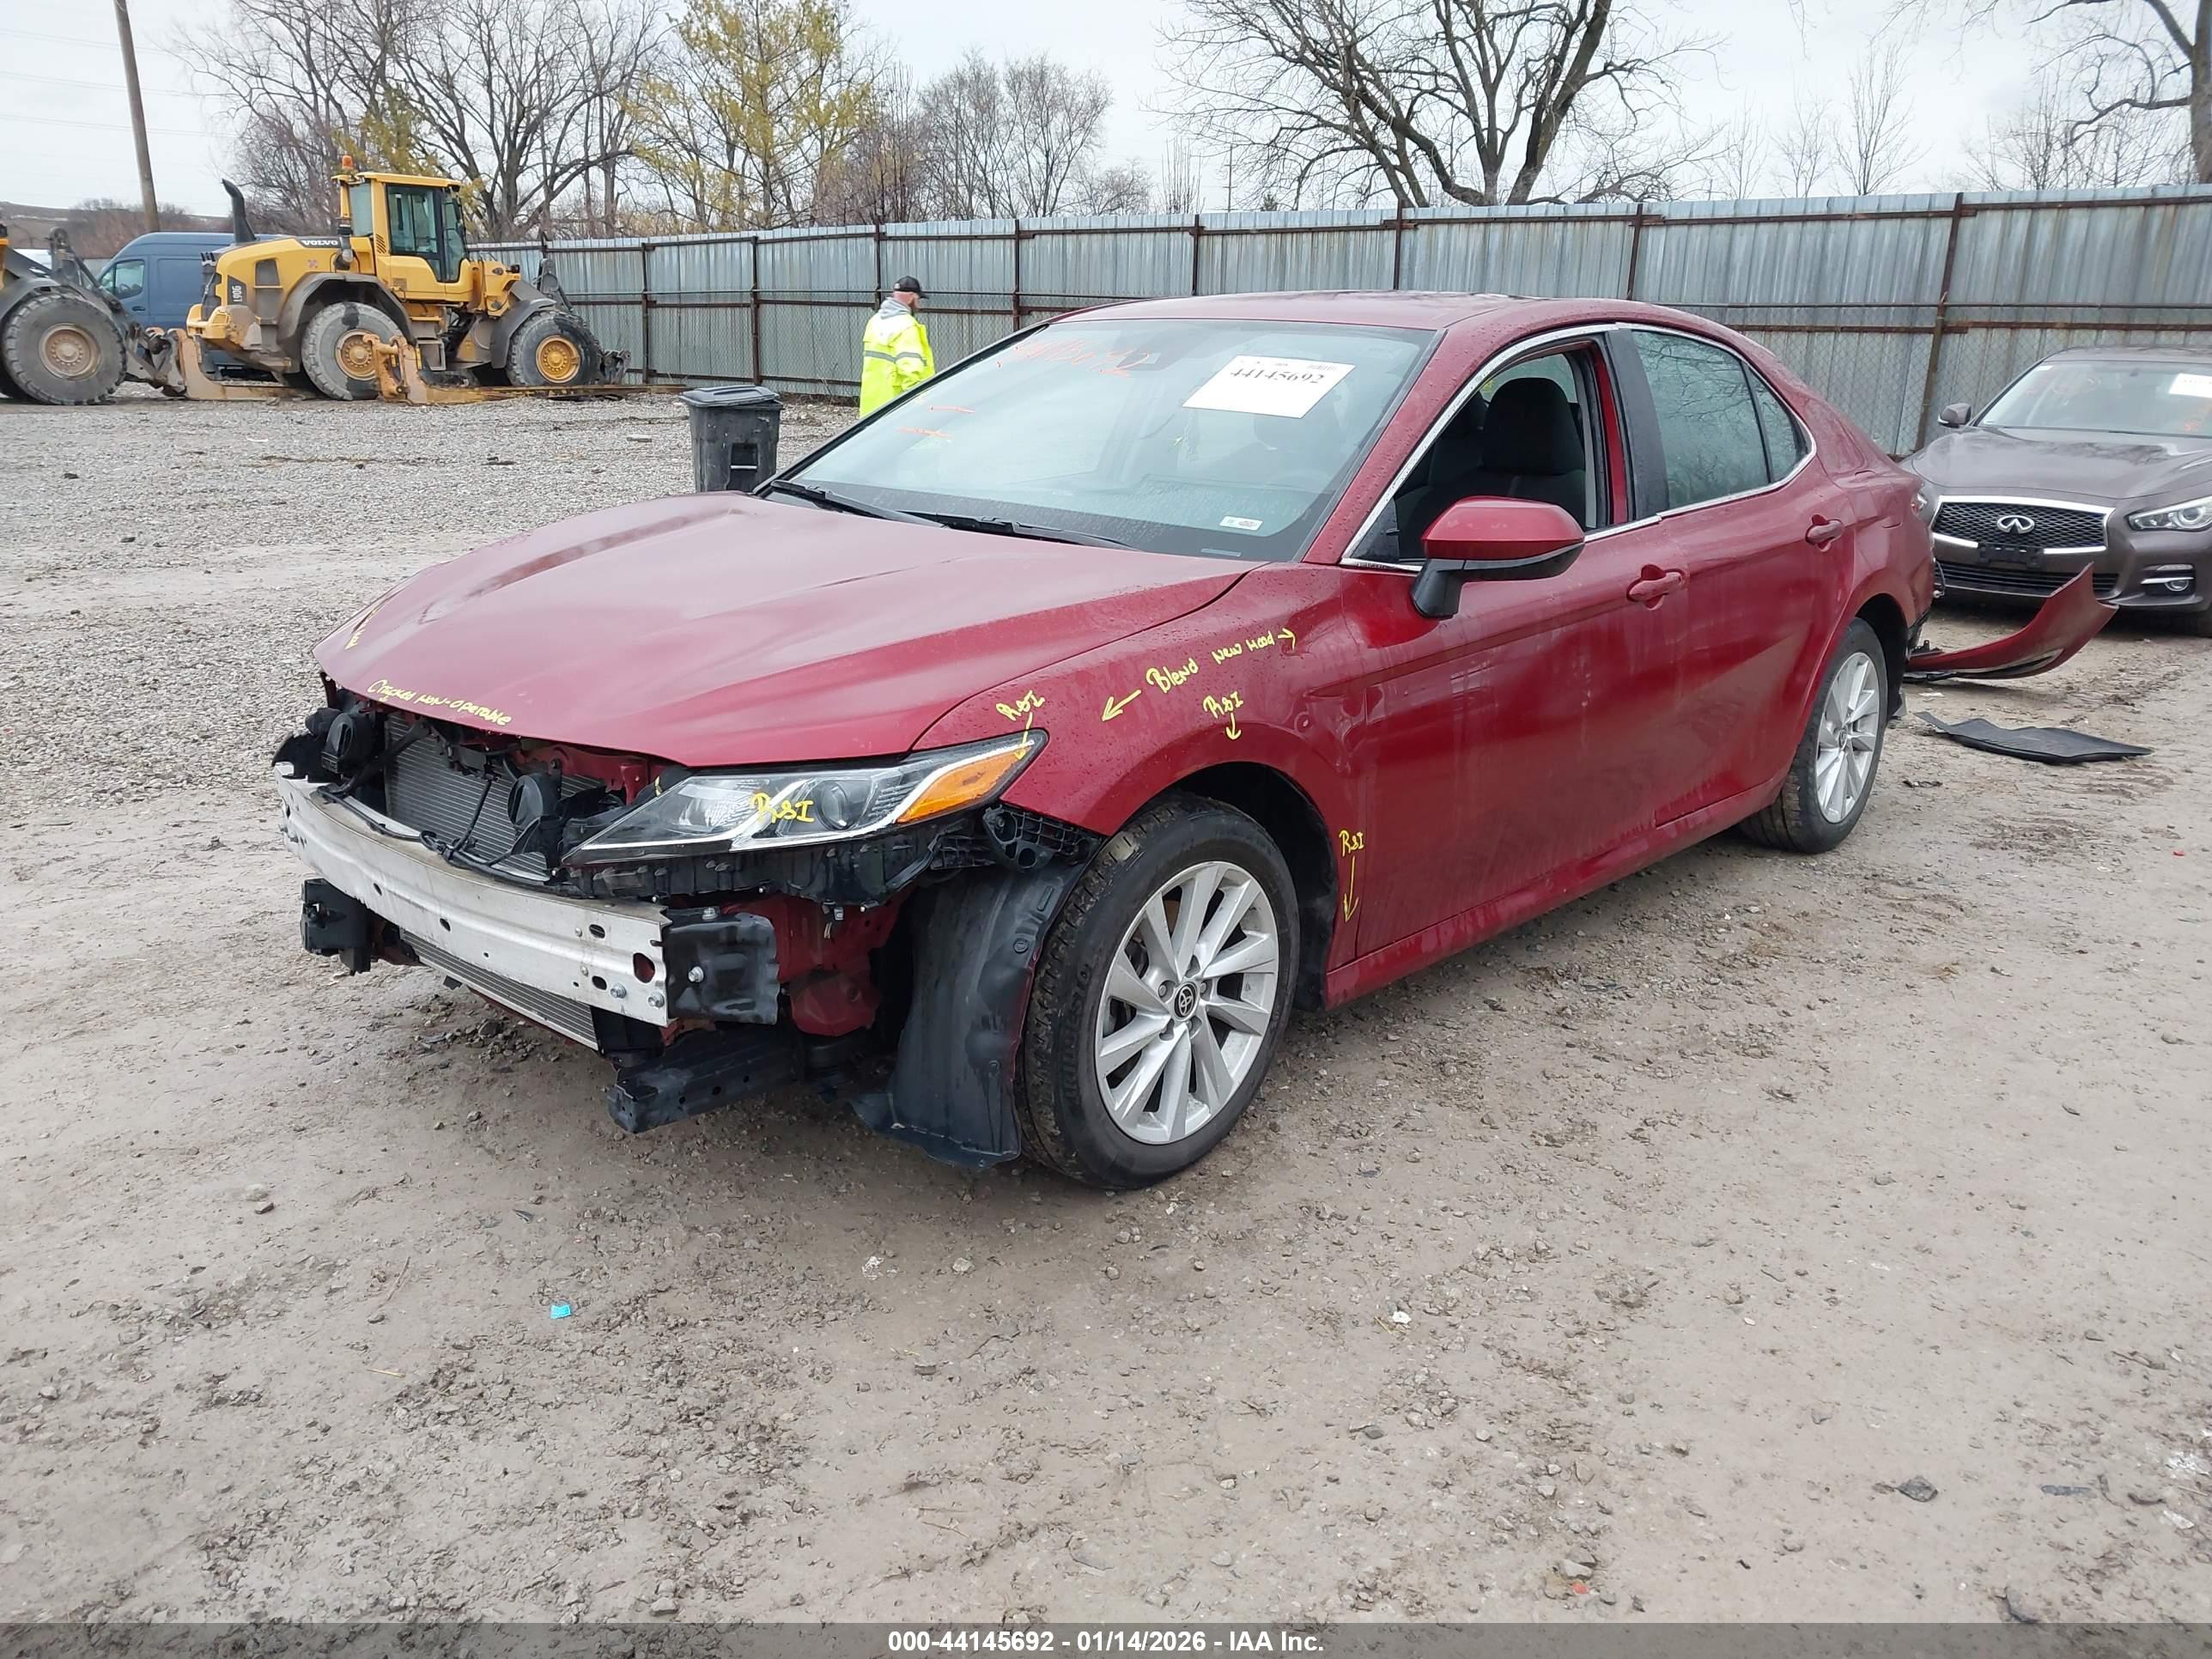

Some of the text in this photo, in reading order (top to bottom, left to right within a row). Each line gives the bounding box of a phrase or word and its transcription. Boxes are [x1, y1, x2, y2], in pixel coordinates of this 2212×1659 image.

[233, 285, 243, 302] L90G
[1230, 368, 1325, 384] 44145692
[1146, 658, 1199, 693] Blend
